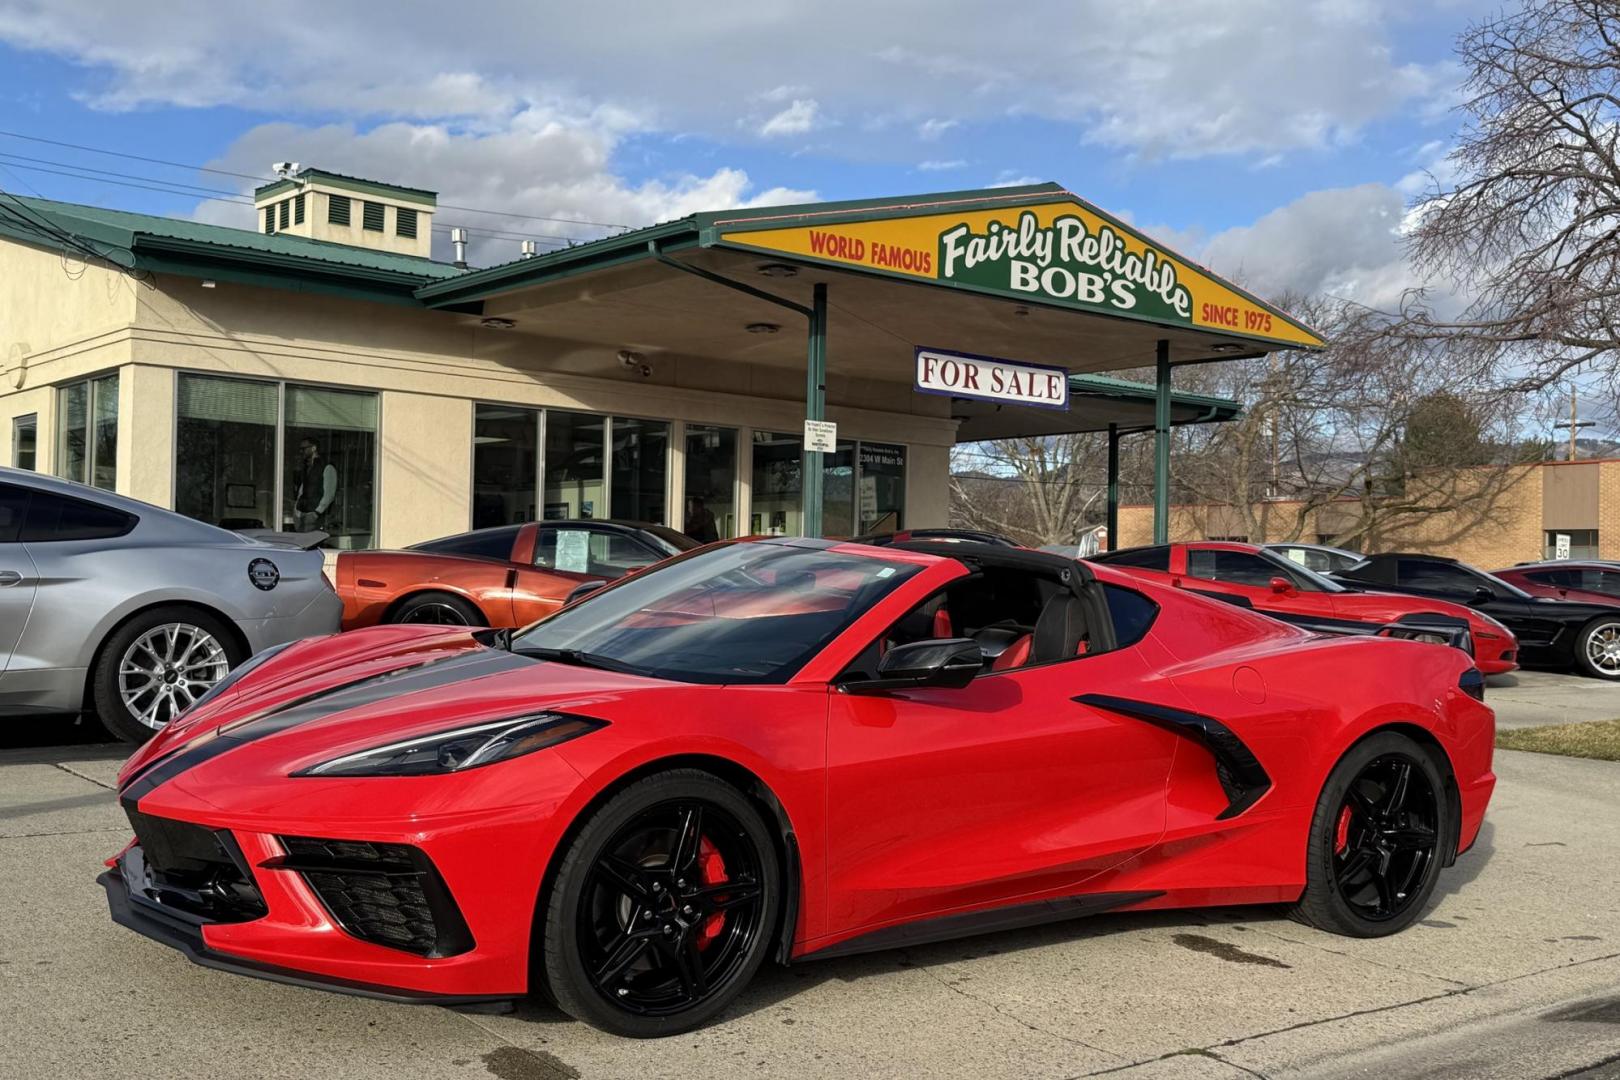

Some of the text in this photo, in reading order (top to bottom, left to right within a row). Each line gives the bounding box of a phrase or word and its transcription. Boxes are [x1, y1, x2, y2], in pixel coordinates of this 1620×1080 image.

[809, 230, 931, 273] WORLD FAMOUS
[943, 214, 1191, 317] Fairly Reliable
[1010, 260, 1137, 309] BOB'S
[1202, 303, 1272, 332] SINCE 1975
[921, 356, 1062, 400] FOR SALE
[874, 455, 881, 464] W
[882, 456, 896, 465] Main
[1557, 548, 1568, 558] 30
